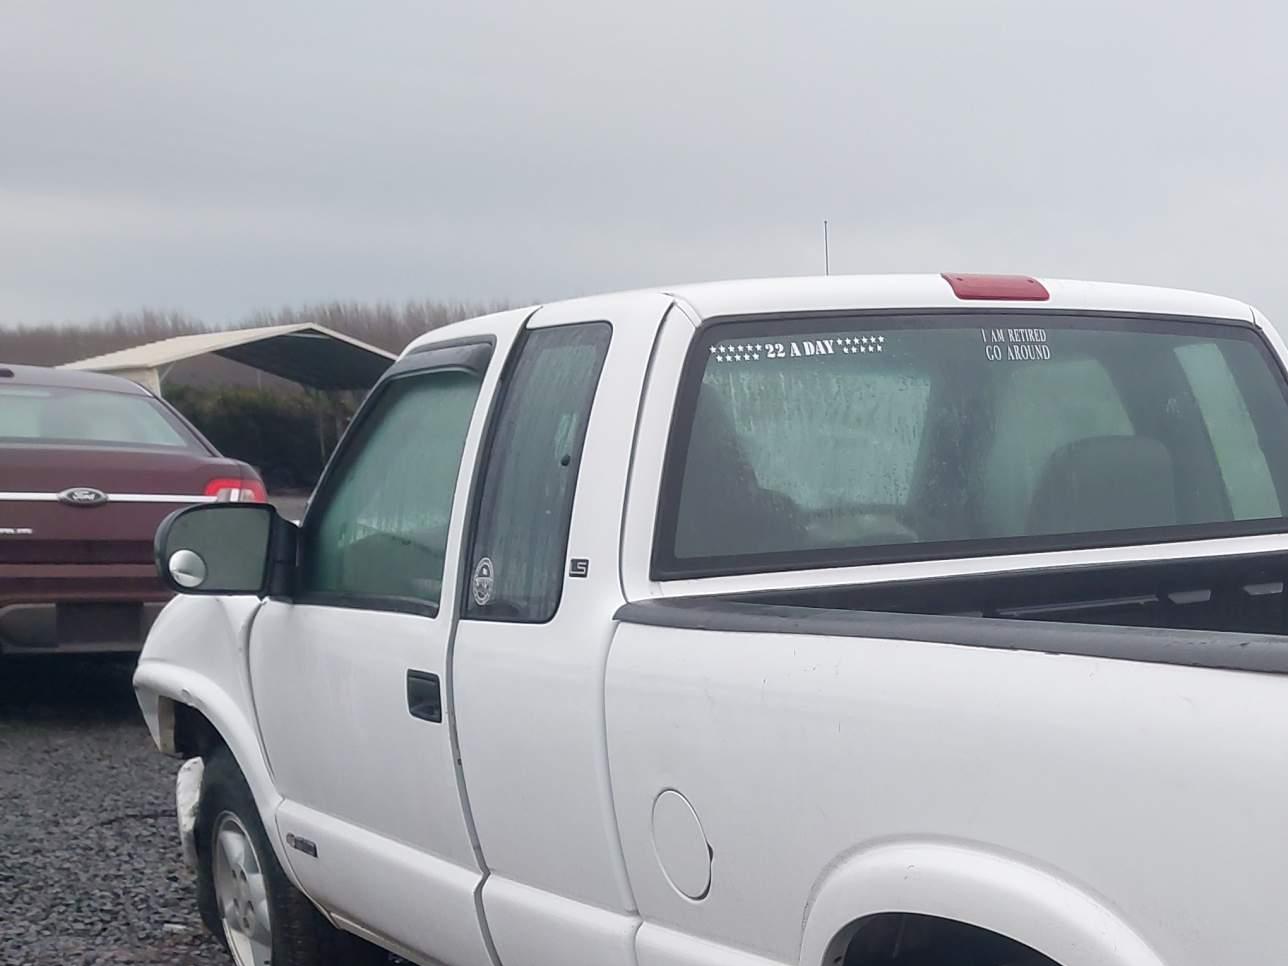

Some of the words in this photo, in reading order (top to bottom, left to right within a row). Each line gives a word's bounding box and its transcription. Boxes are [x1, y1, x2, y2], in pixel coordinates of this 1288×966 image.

[981, 328, 987, 342] I
[991, 328, 1005, 342] AM
[1007, 328, 1047, 342] RETIRED
[764, 343, 786, 358] 22
[790, 342, 802, 357] A
[802, 339, 835, 356] DAY
[985, 344, 1002, 361] GO
[1007, 344, 1051, 361] AROUND
[569, 559, 589, 577] LS
